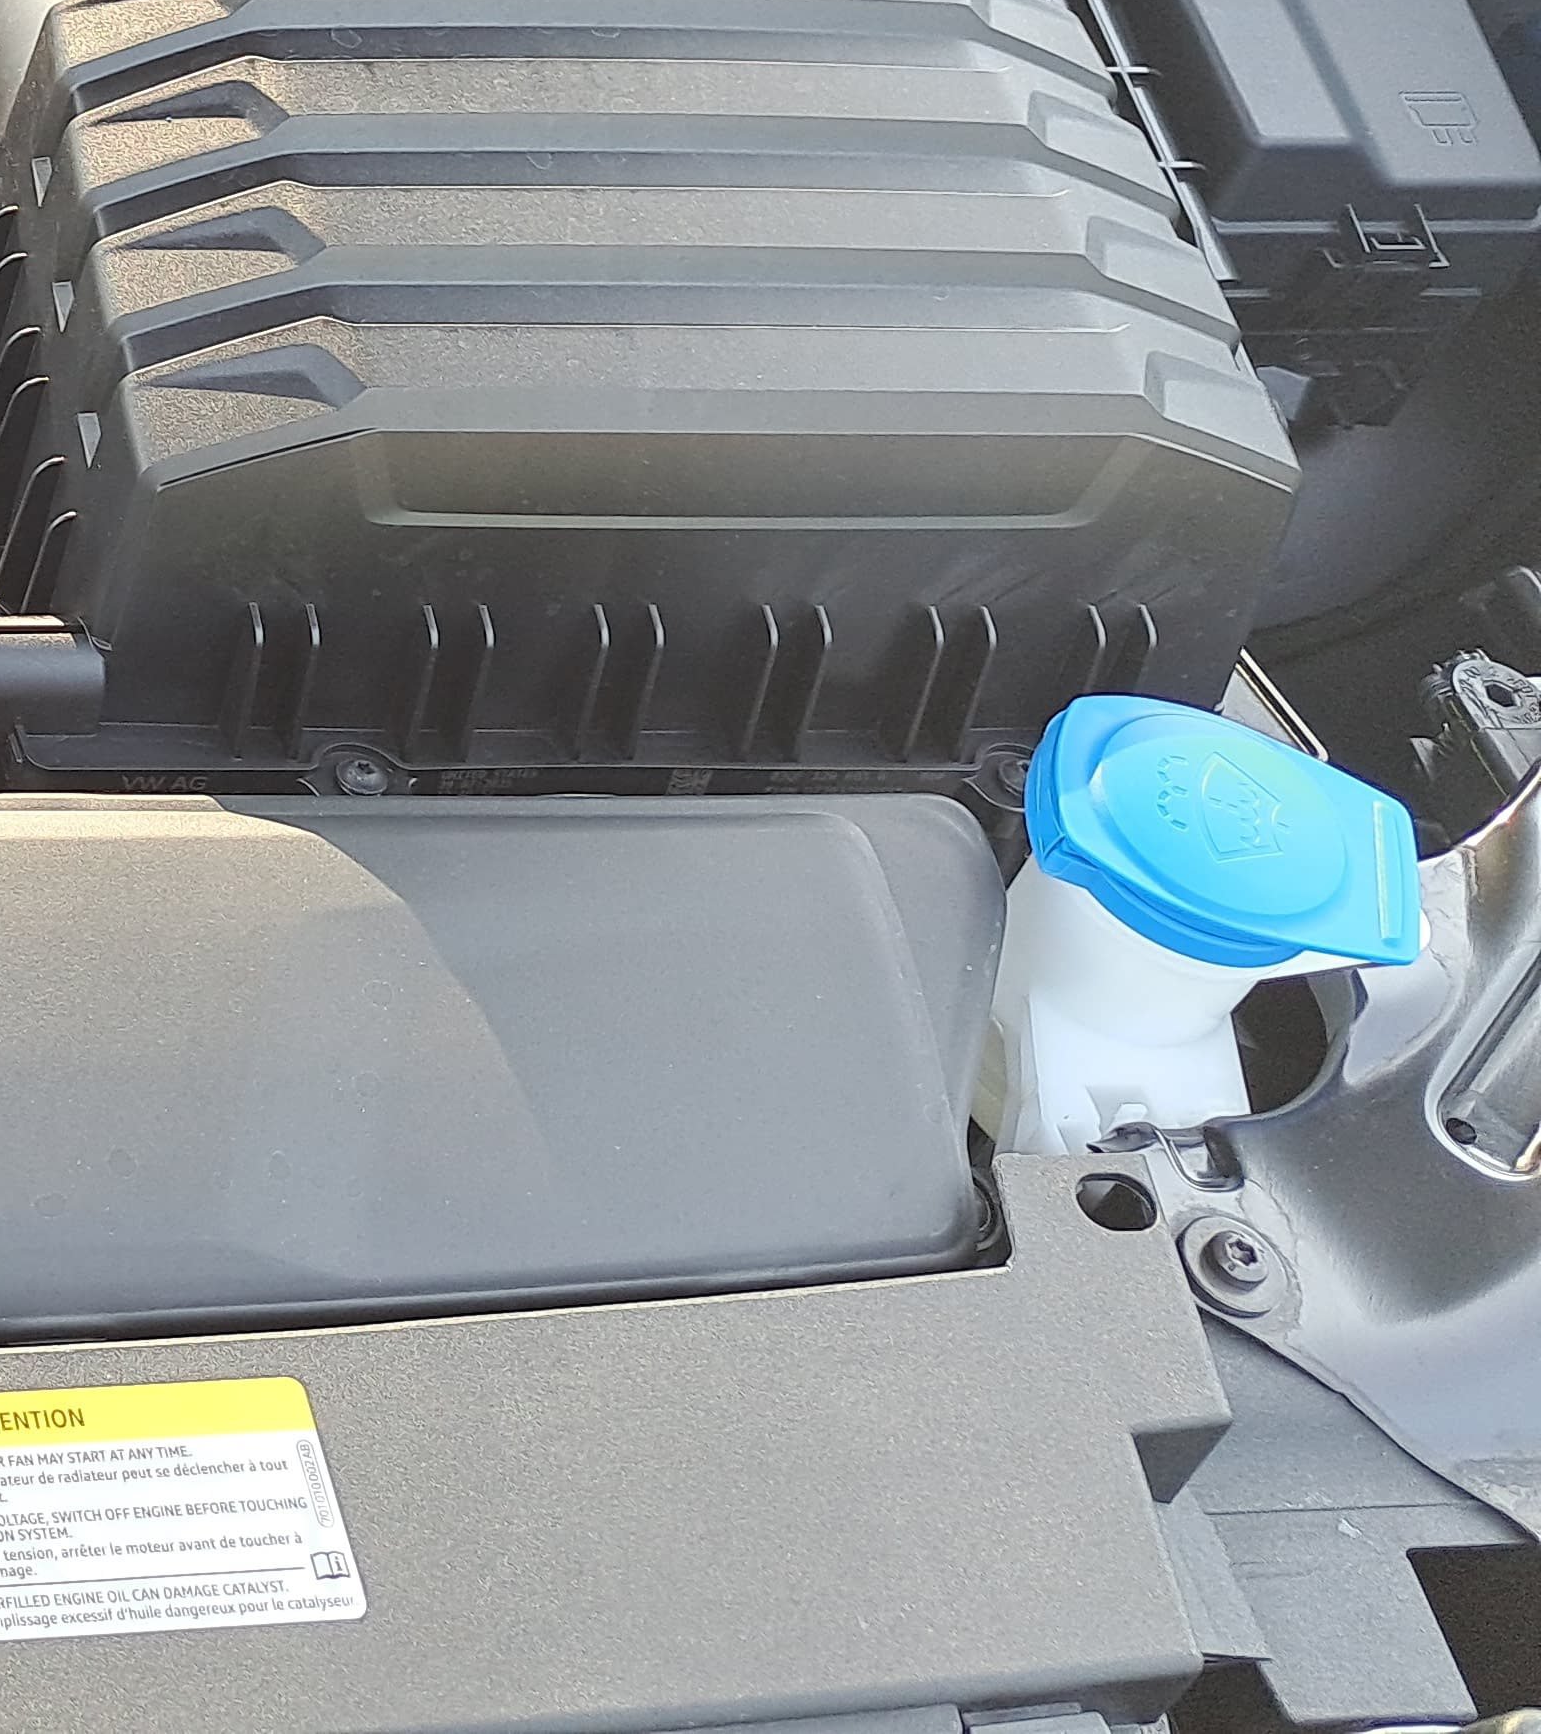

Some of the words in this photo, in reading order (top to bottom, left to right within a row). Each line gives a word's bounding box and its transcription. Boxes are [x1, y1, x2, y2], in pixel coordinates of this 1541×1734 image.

[7, 1454, 35, 1467] FAN
[37, 1452, 64, 1466] MAY
[67, 1450, 105, 1464] START
[110, 1449, 125, 1462] AT
[128, 1447, 154, 1461] ANY
[38, 1471, 55, 1485] de
[58, 1469, 118, 1483] radiateur
[173, 1461, 245, 1477] déclencher
[259, 1460, 289, 1472] tout
[51, 1509, 103, 1524] SWITCH
[105, 1507, 130, 1521] OFF
[133, 1504, 183, 1519] ENGINE
[185, 1501, 238, 1516] BEFORE
[238, 1496, 308, 1512] TOUCHING
[3, 1547, 58, 1562] tension,
[61, 1544, 106, 1559] arrêter
[109, 1542, 123, 1556] le
[126, 1542, 174, 1555] moteur
[179, 1538, 217, 1552] avant
[219, 1535, 237, 1549] de
[239, 1533, 290, 1548] toucher
[17, 1527, 73, 1542] SYSTEM.
[53, 1591, 105, 1606] ENGINE
[107, 1590, 131, 1604] OIL
[132, 1588, 160, 1602] CAN
[163, 1584, 221, 1600] DAMAGE
[222, 1580, 289, 1596] CATALYST.
[61, 1608, 113, 1624] excessif
[116, 1605, 162, 1621] d'huile
[165, 1604, 236, 1620] dangereux
[238, 1602, 269, 1616] pour
[271, 1597, 285, 1611] le
